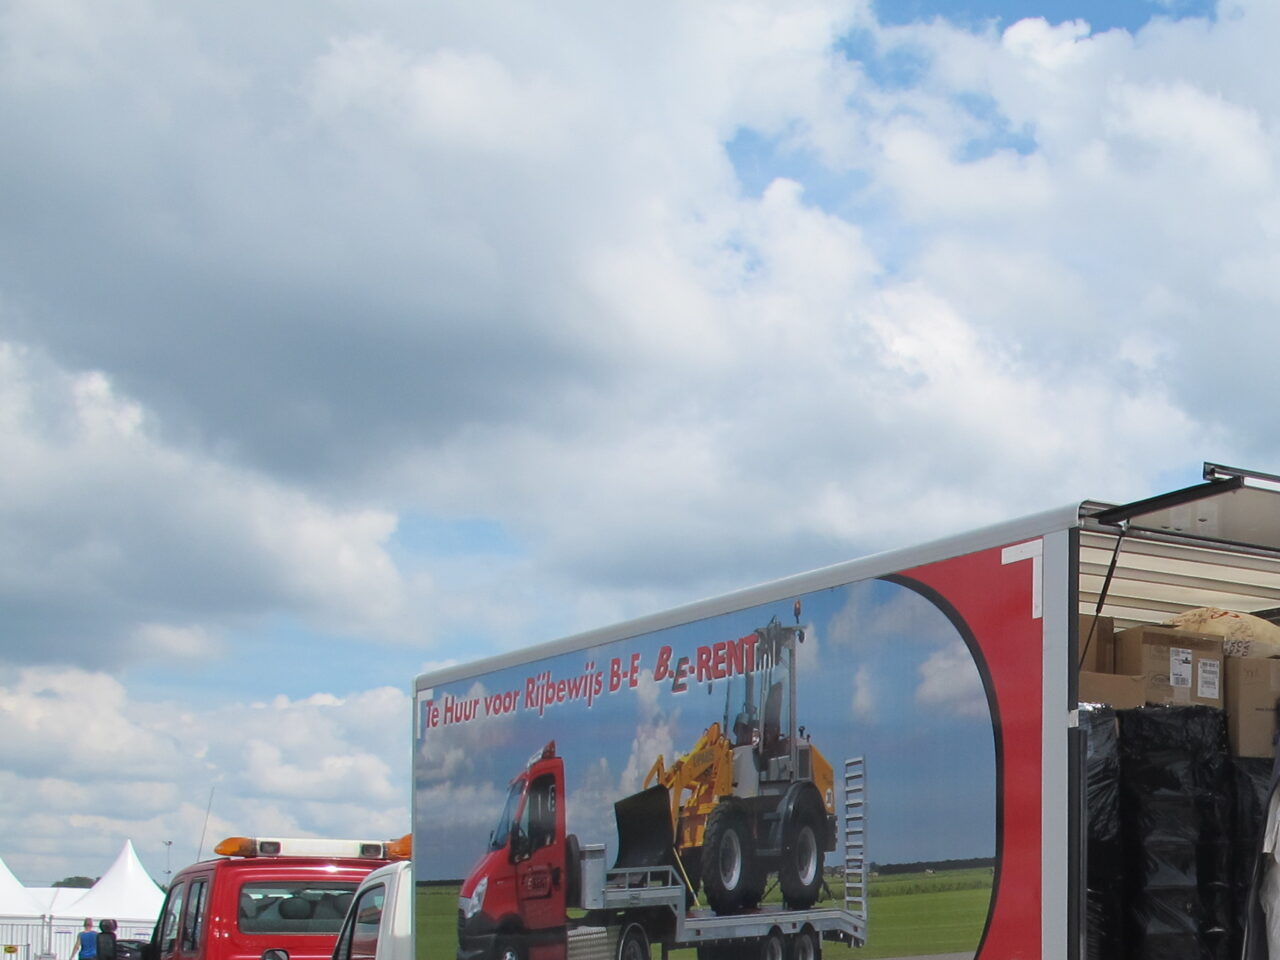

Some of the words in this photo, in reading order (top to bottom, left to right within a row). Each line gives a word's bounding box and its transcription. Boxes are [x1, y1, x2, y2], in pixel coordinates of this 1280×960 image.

[426, 700, 439, 728] Te
[444, 695, 479, 725] Huur
[484, 689, 520, 717] voor
[525, 661, 603, 718] Rijbewijs
